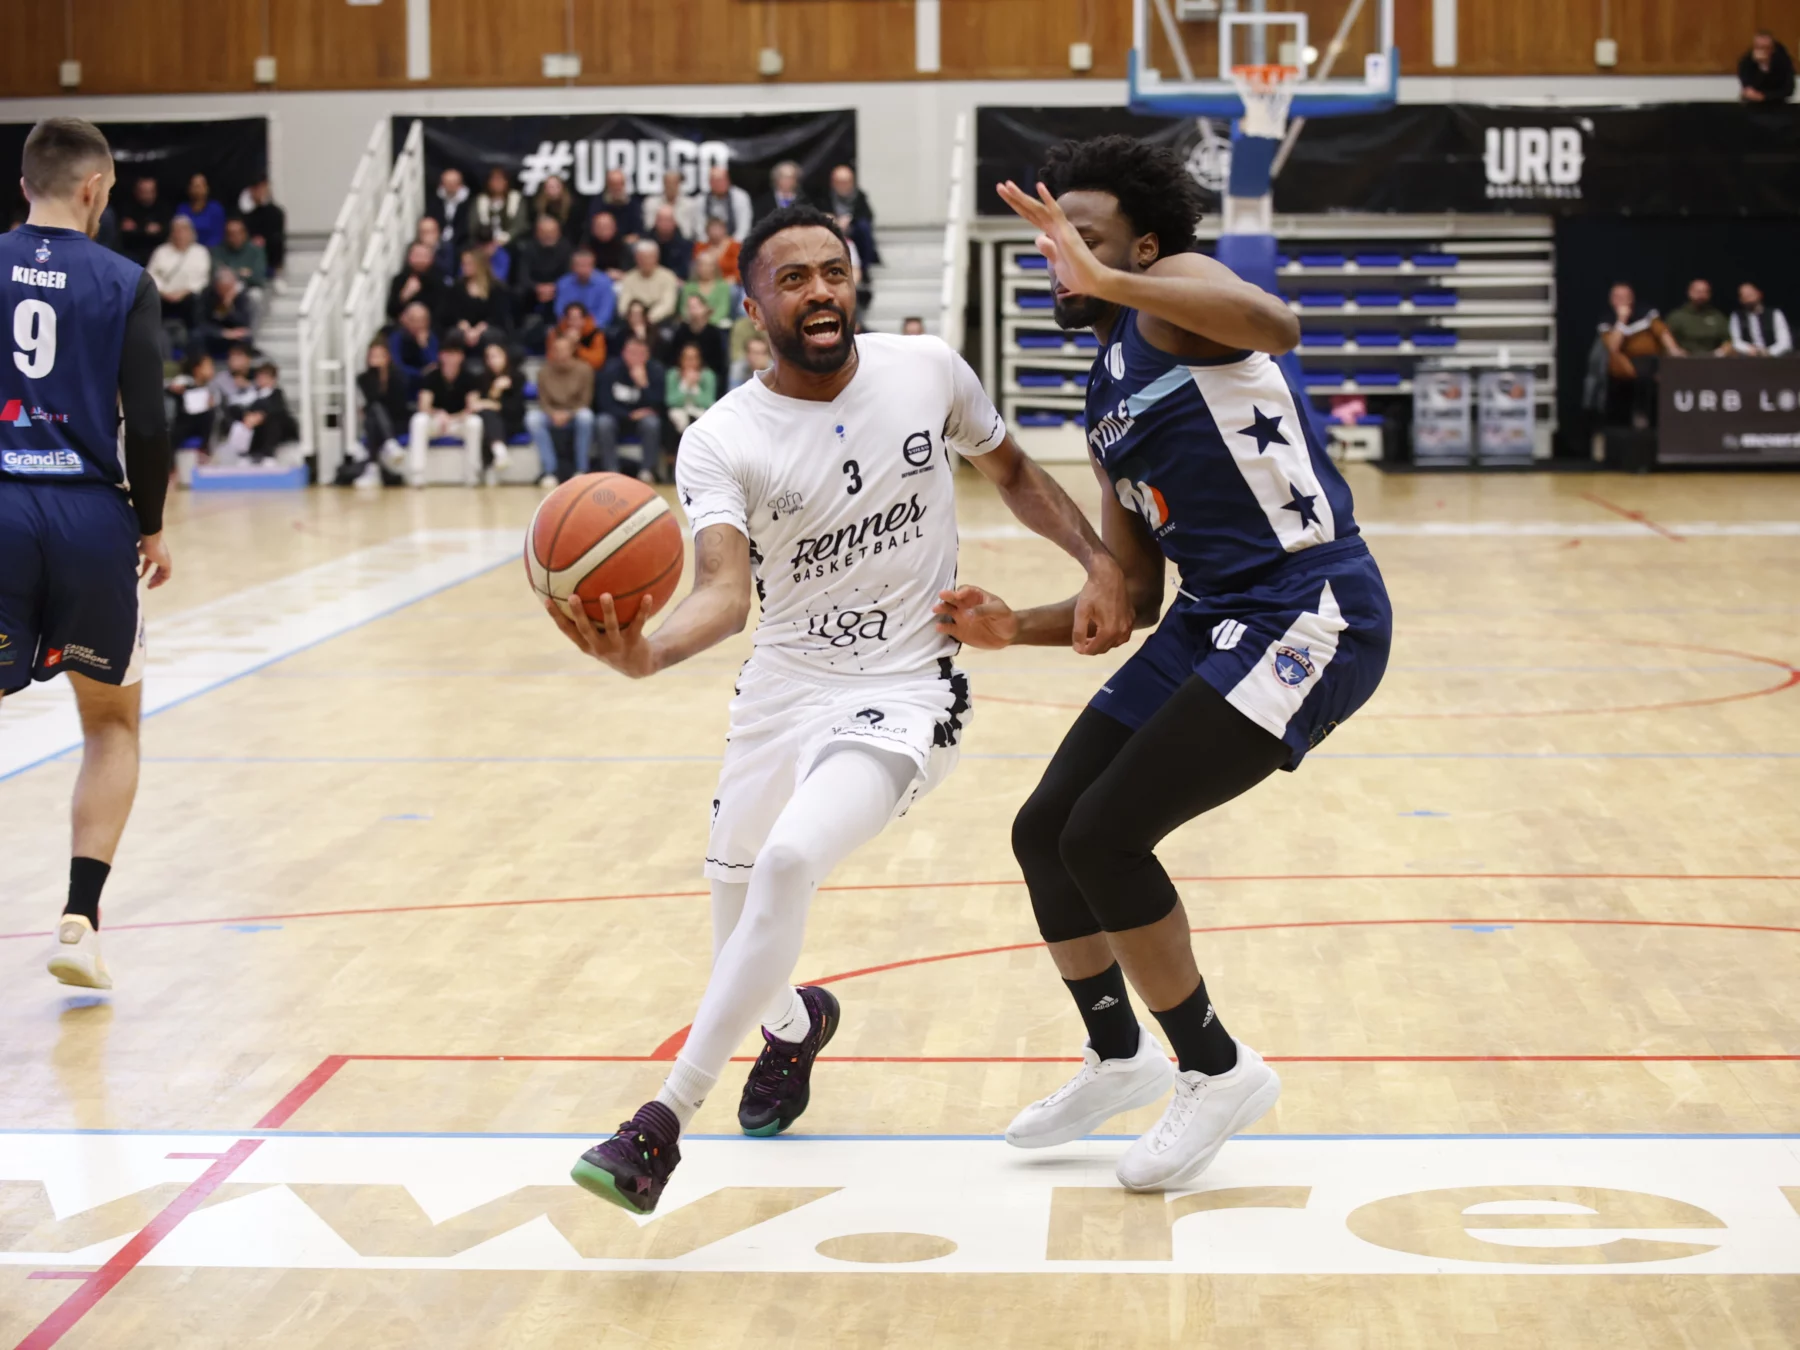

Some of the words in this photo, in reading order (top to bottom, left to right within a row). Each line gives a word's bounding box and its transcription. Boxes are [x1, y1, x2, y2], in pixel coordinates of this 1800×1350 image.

[1484, 126, 1584, 185] URB
[12, 265, 67, 289] KIEGER
[13, 299, 57, 379] 9
[1673, 389, 1742, 412] URB
[1759, 389, 1800, 412] LO
[908, 445, 930, 454] VOLVO
[1088, 399, 1136, 467] TOILE
[842, 459, 863, 495] 3
[790, 493, 928, 569] Rennes
[793, 526, 924, 584] BASKETBALL
[64, 643, 95, 655] CAISSE
[1092, 998, 1119, 1011] adidas
